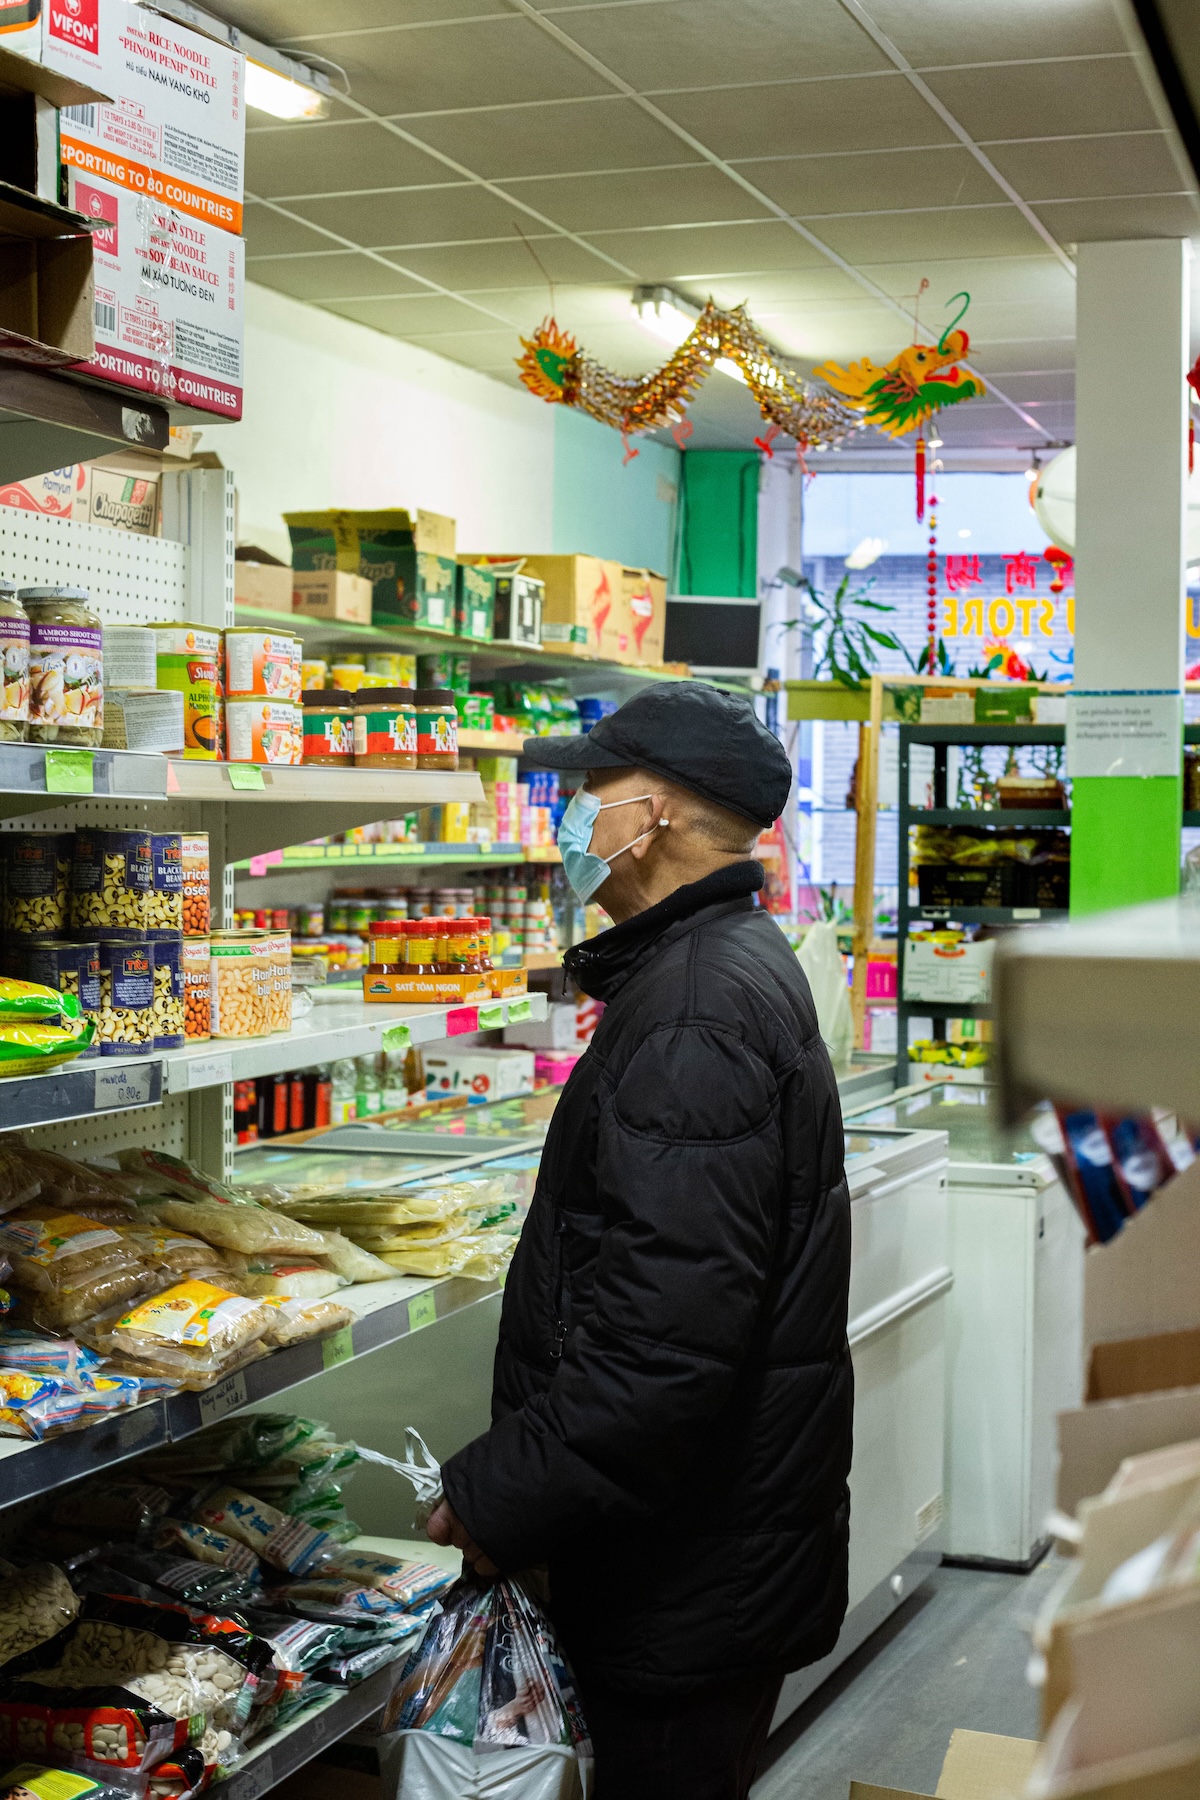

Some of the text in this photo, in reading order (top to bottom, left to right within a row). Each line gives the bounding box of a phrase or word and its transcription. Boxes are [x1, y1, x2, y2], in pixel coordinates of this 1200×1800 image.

[52, 10, 94, 43] VIFON
[149, 31, 171, 51] RICE
[173, 41, 210, 69] NOODLE
[149, 68, 168, 87] NAM
[169, 77, 192, 97] VANG
[193, 88, 210, 104] KHÔ
[190, 67, 218, 89] STYLE
[61, 143, 233, 222] XPORTING TO 80 COUNTRIES
[180, 224, 206, 246] STYLE
[171, 239, 207, 264] NOODLE
[192, 265, 219, 287] SAUCE
[199, 287, 215, 303] ĐEN
[88, 352, 143, 380] PORTING
[145, 367, 160, 385] TO
[178, 379, 237, 408] COUNTRIES
[42, 477, 71, 496] Ramyun
[93, 492, 153, 529] Chapagetti
[38, 629, 90, 639] BAMBOO SHOOT
[181, 869, 210, 880] aricots
[126, 960, 149, 970] TRS
[436, 983, 460, 992] NGON
